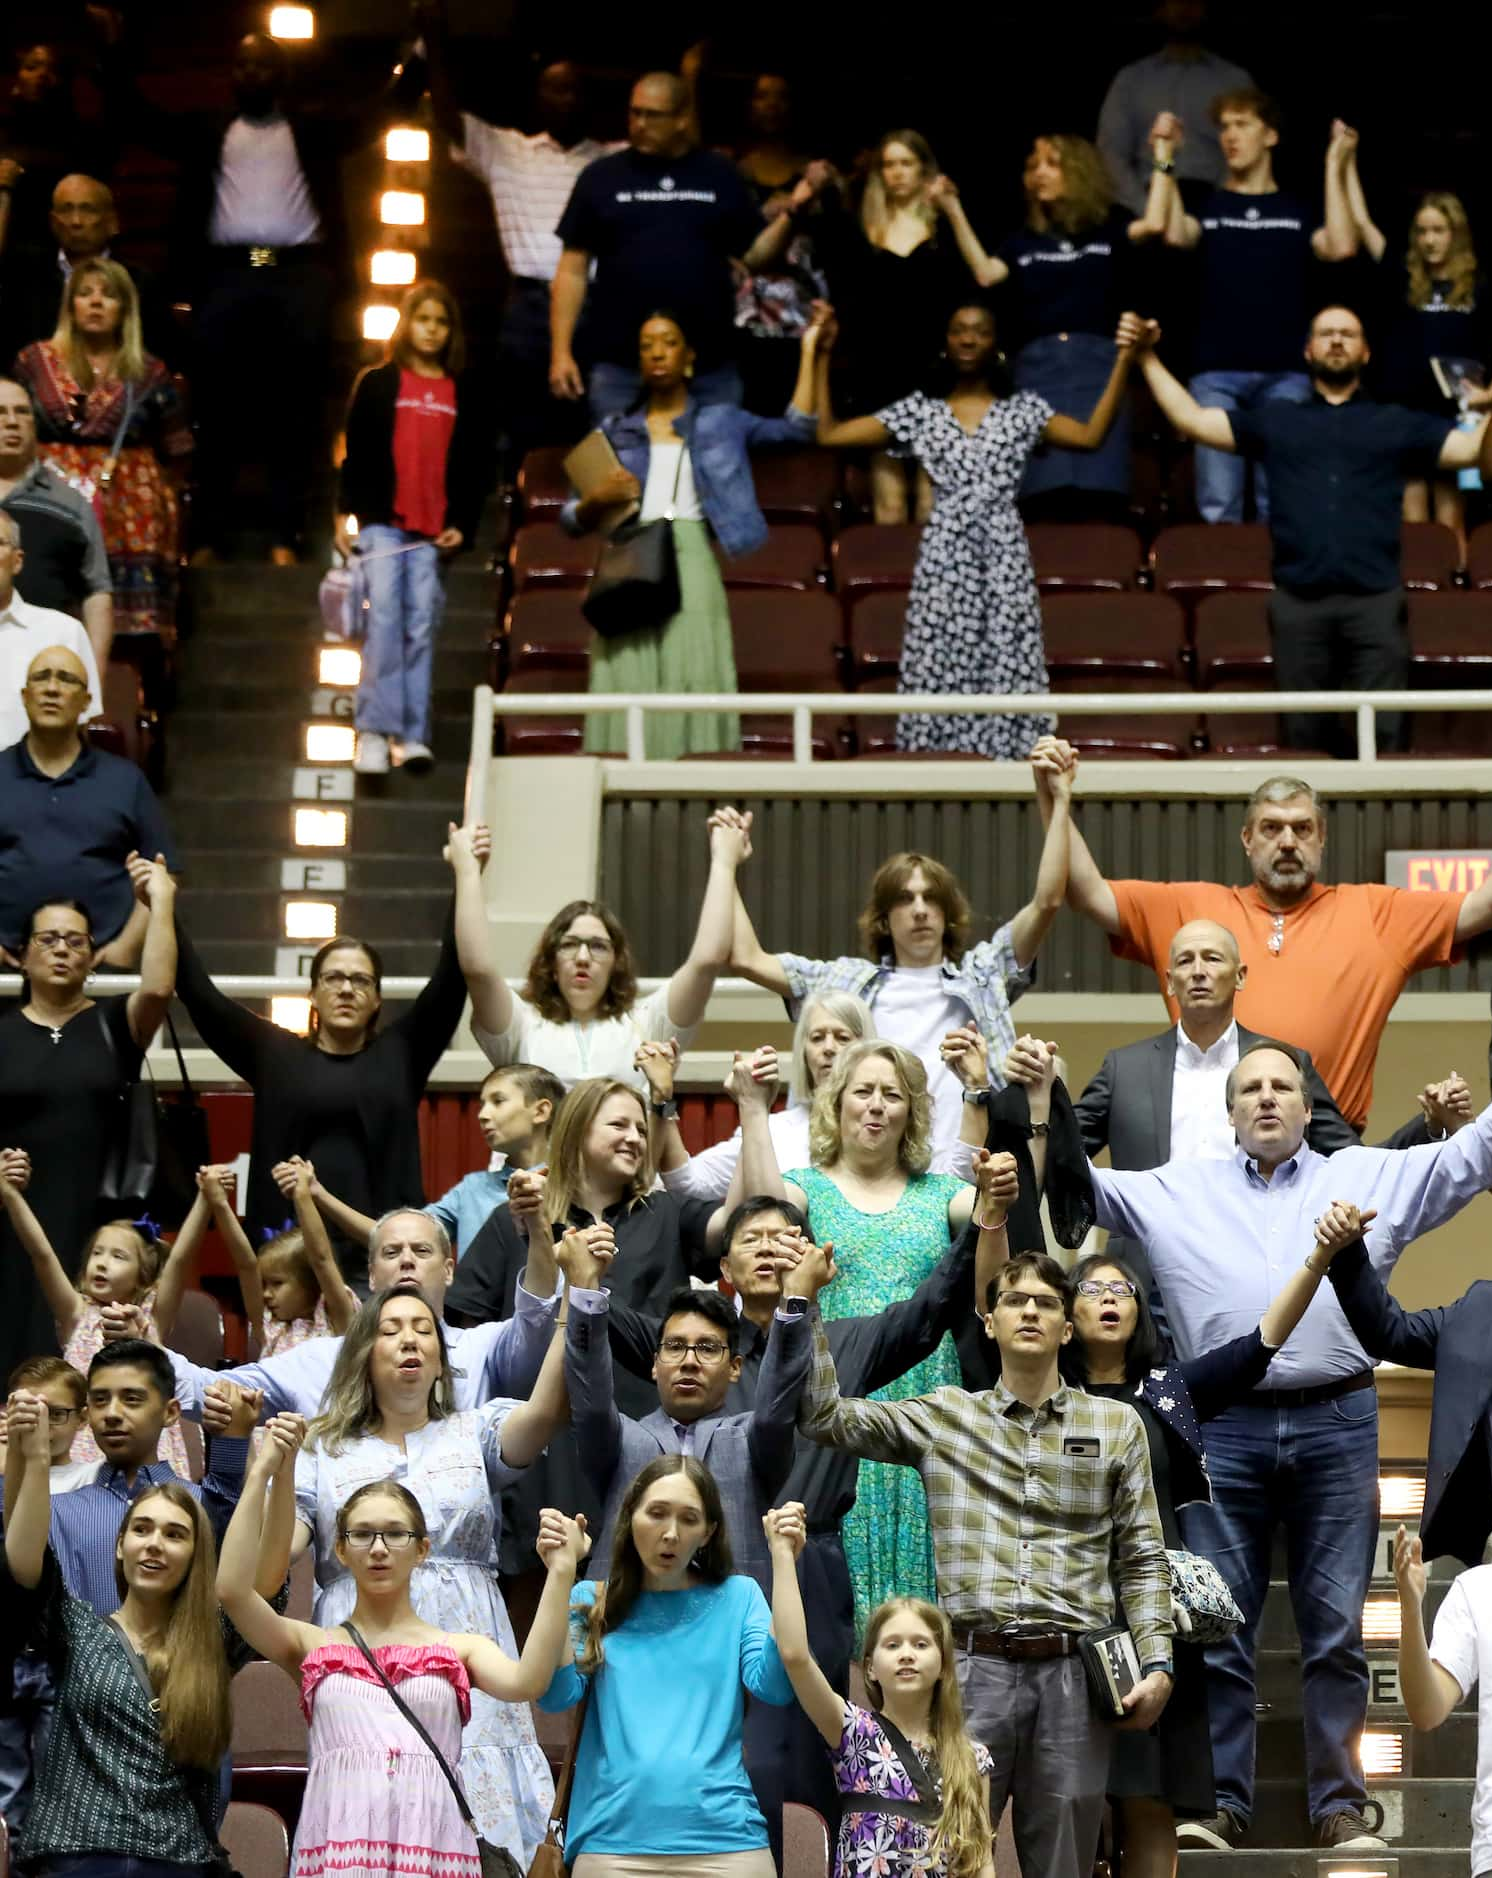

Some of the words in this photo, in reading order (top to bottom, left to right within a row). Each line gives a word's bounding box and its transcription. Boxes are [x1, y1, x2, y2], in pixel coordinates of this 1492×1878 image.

[330, 696, 353, 716] G
[315, 775, 335, 799] F
[1408, 858, 1490, 892] EXIT
[1372, 1669, 1399, 1703] E
